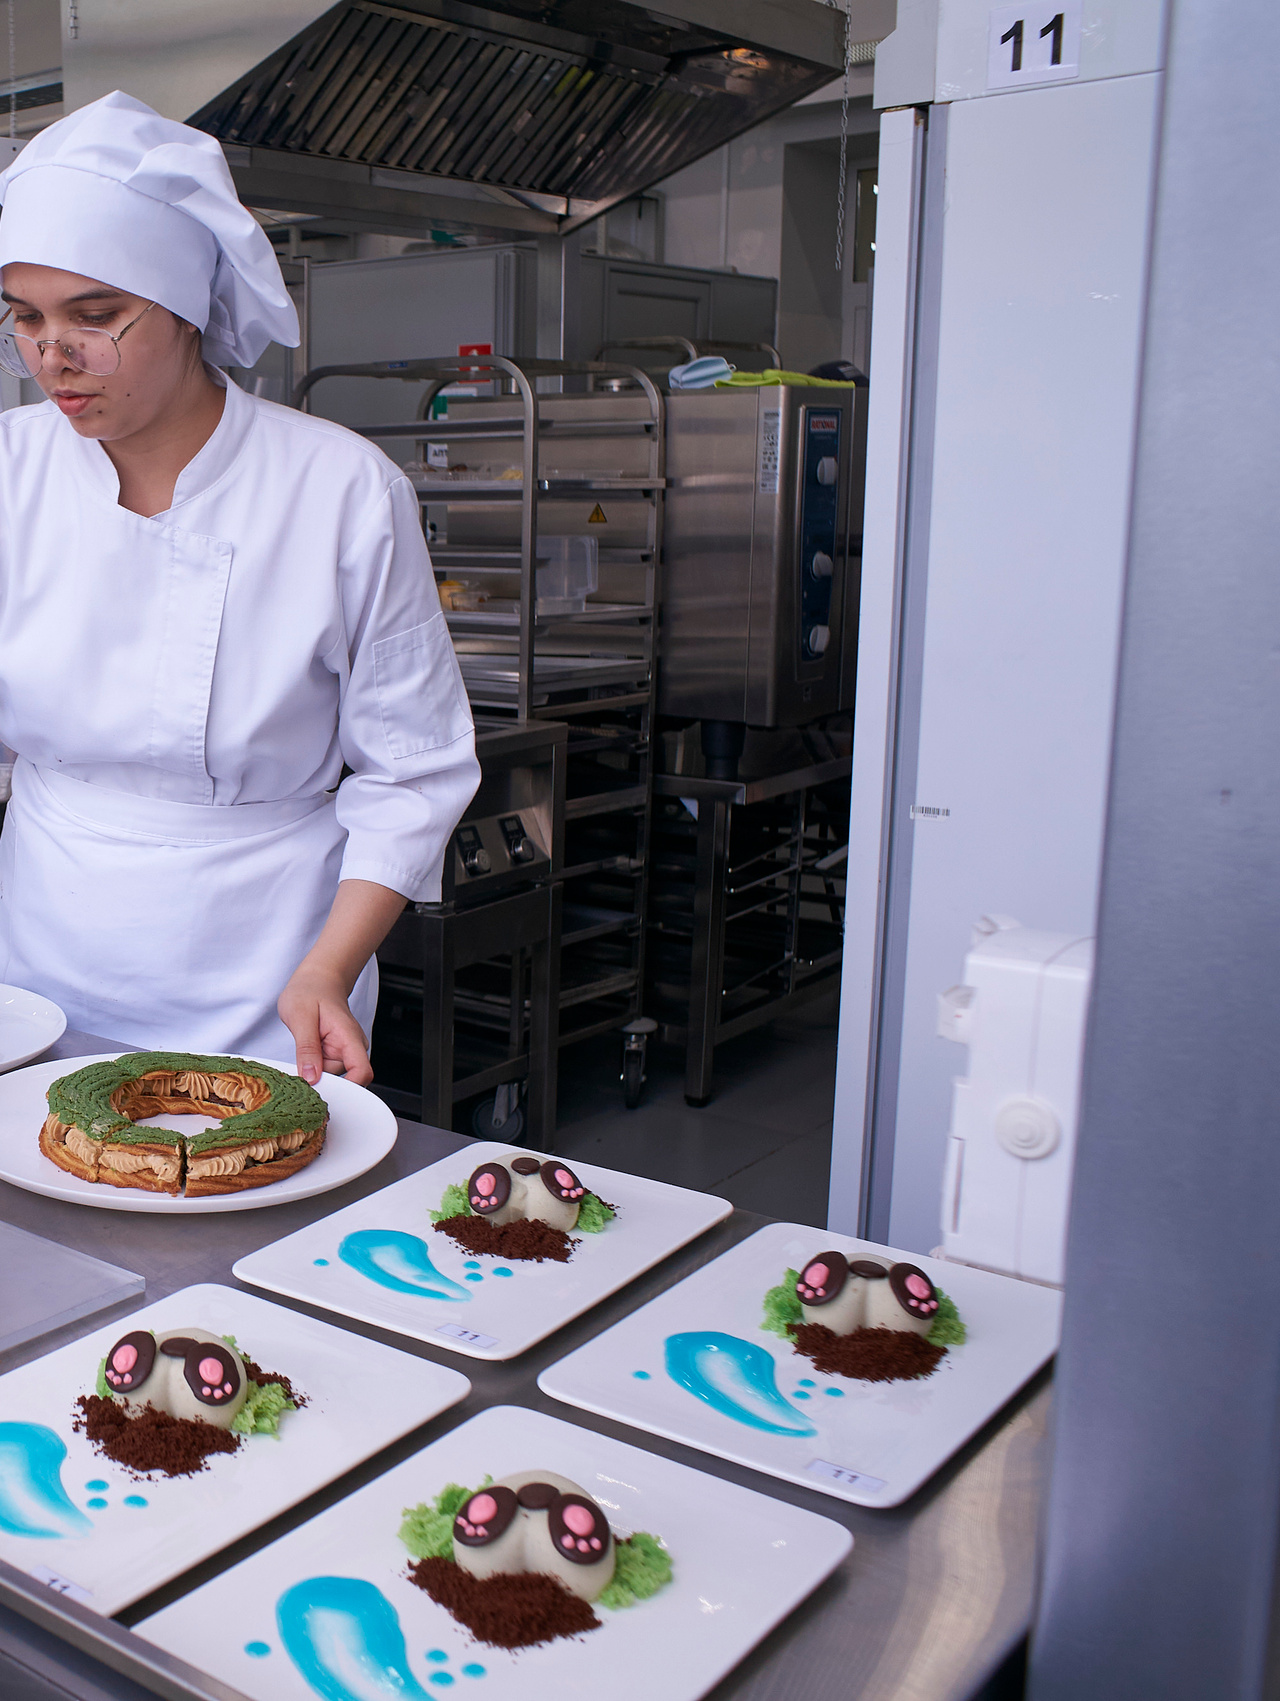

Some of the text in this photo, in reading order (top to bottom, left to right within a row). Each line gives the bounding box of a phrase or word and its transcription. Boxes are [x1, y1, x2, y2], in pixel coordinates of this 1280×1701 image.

[1000, 12, 1064, 72] 11
[458, 1330, 481, 1341] 11
[832, 1468, 860, 1484] 11
